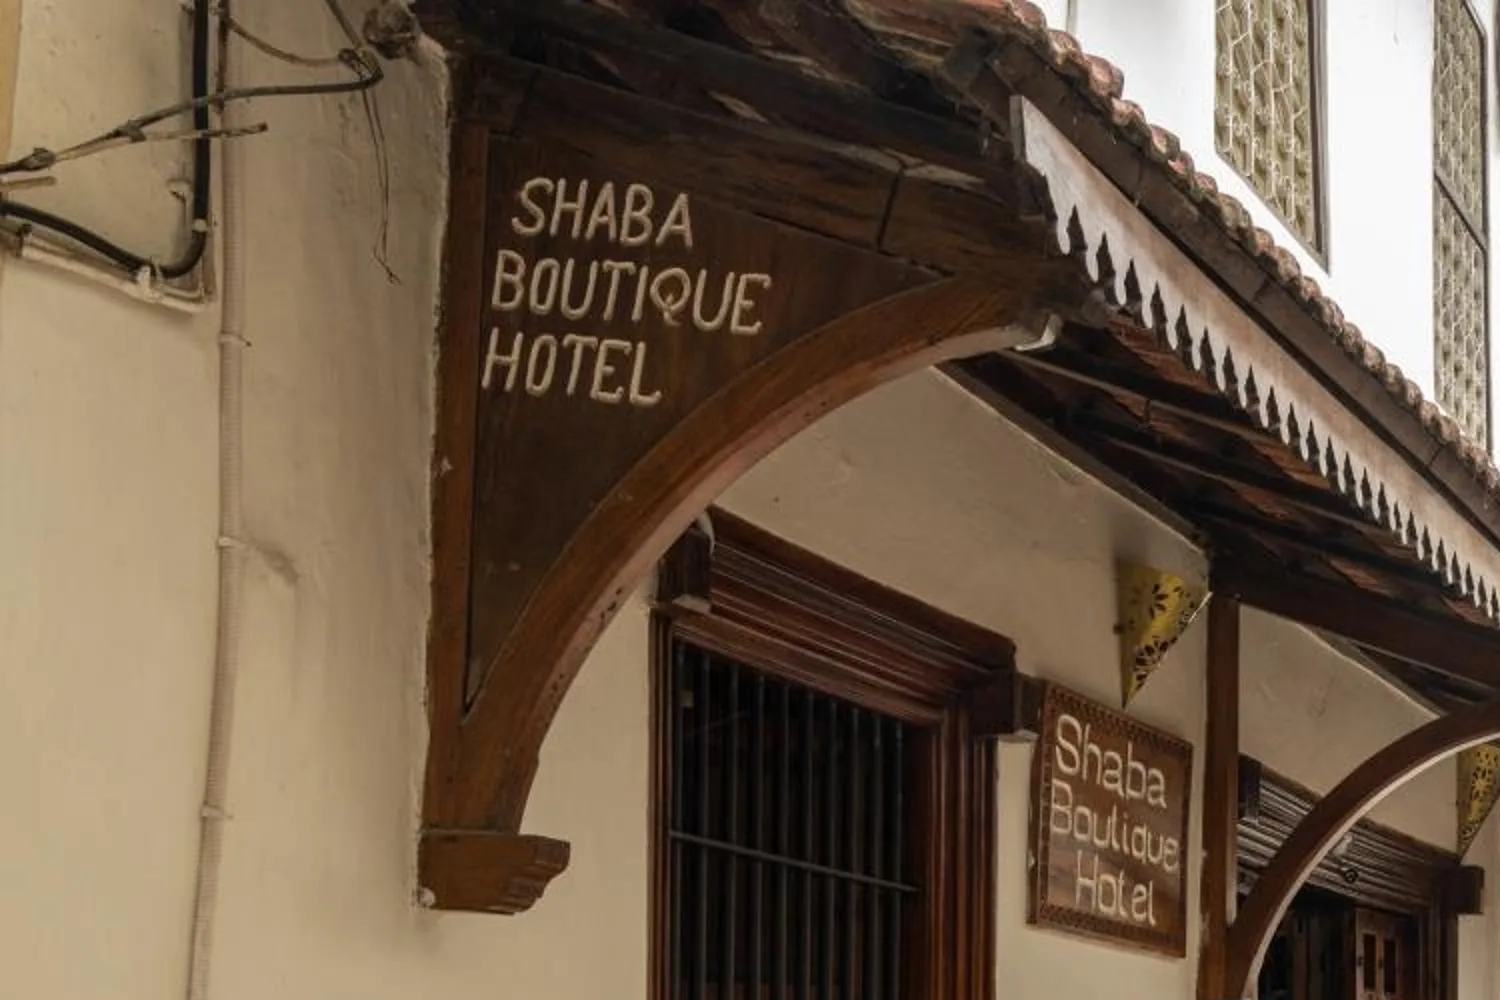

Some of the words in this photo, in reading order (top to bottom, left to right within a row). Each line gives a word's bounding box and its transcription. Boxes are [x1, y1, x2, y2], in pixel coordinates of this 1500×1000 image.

[511, 177, 693, 248] SHABA
[491, 250, 772, 336] BOUTIQUE
[481, 327, 662, 407] HOTEL
[1055, 713, 1168, 809] Shaba
[1051, 777, 1180, 874] Boutique
[1075, 850, 1157, 927] Hotel
